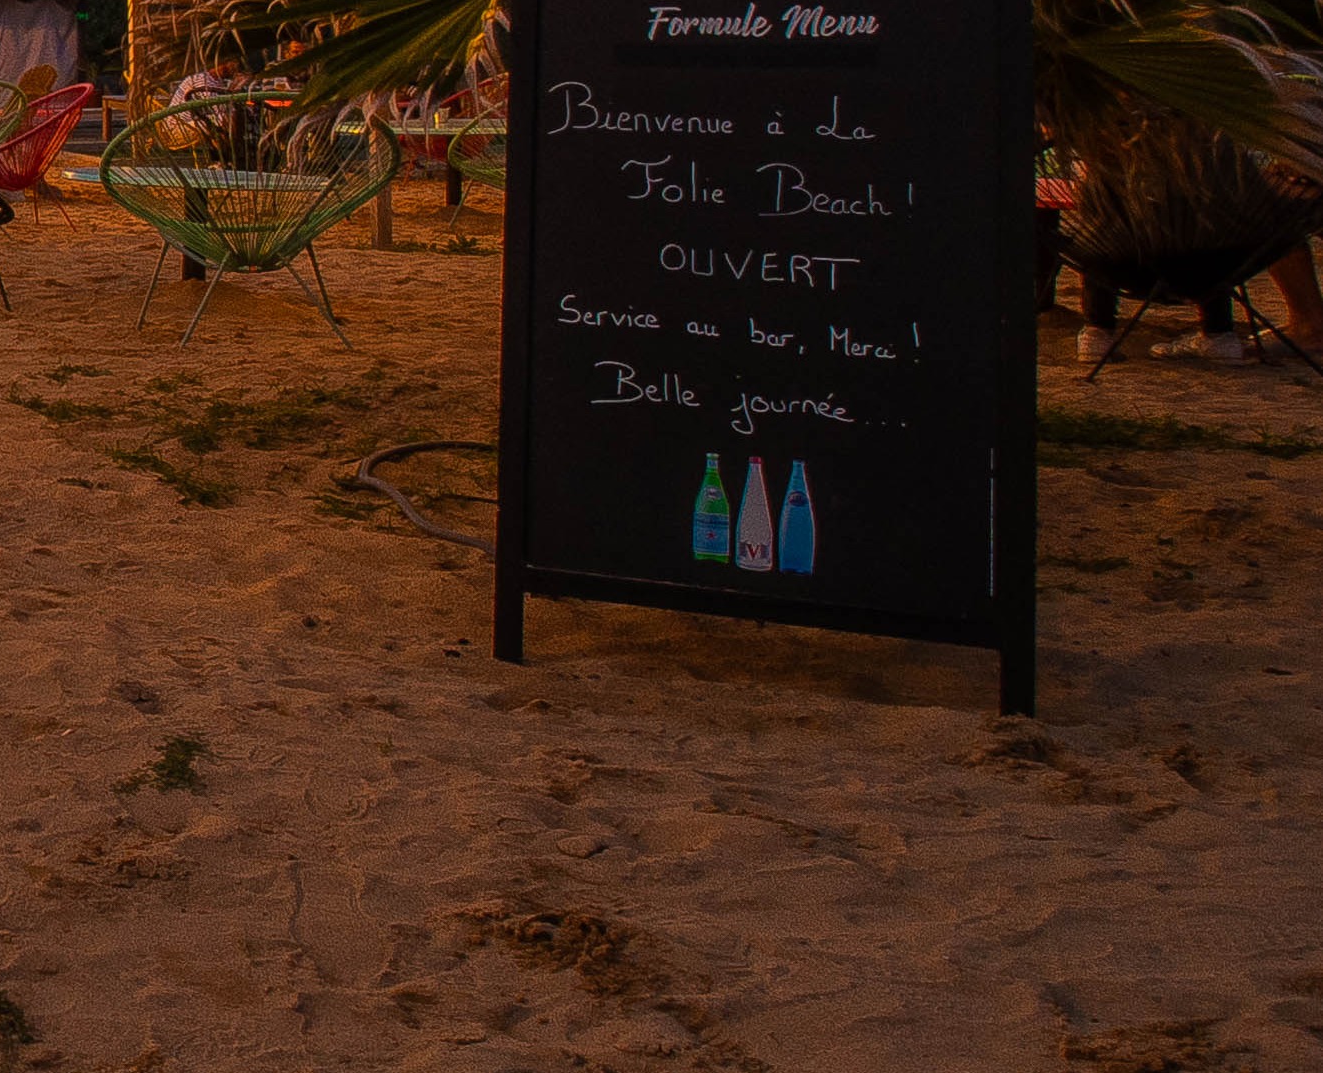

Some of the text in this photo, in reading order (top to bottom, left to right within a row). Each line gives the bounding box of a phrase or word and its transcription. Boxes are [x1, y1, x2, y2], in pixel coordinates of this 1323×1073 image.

[648, 2, 880, 41] Formule Menu
[547, 81, 734, 136] Bienvenue
[766, 111, 785, 136] à
[620, 155, 726, 204] Folie
[755, 162, 892, 217] Beach
[659, 242, 861, 291] OUVERT
[557, 293, 661, 329] Service
[686, 319, 721, 338] au
[749, 317, 805, 356] bar,
[829, 325, 897, 360] Merci
[590, 360, 701, 407] Belle
